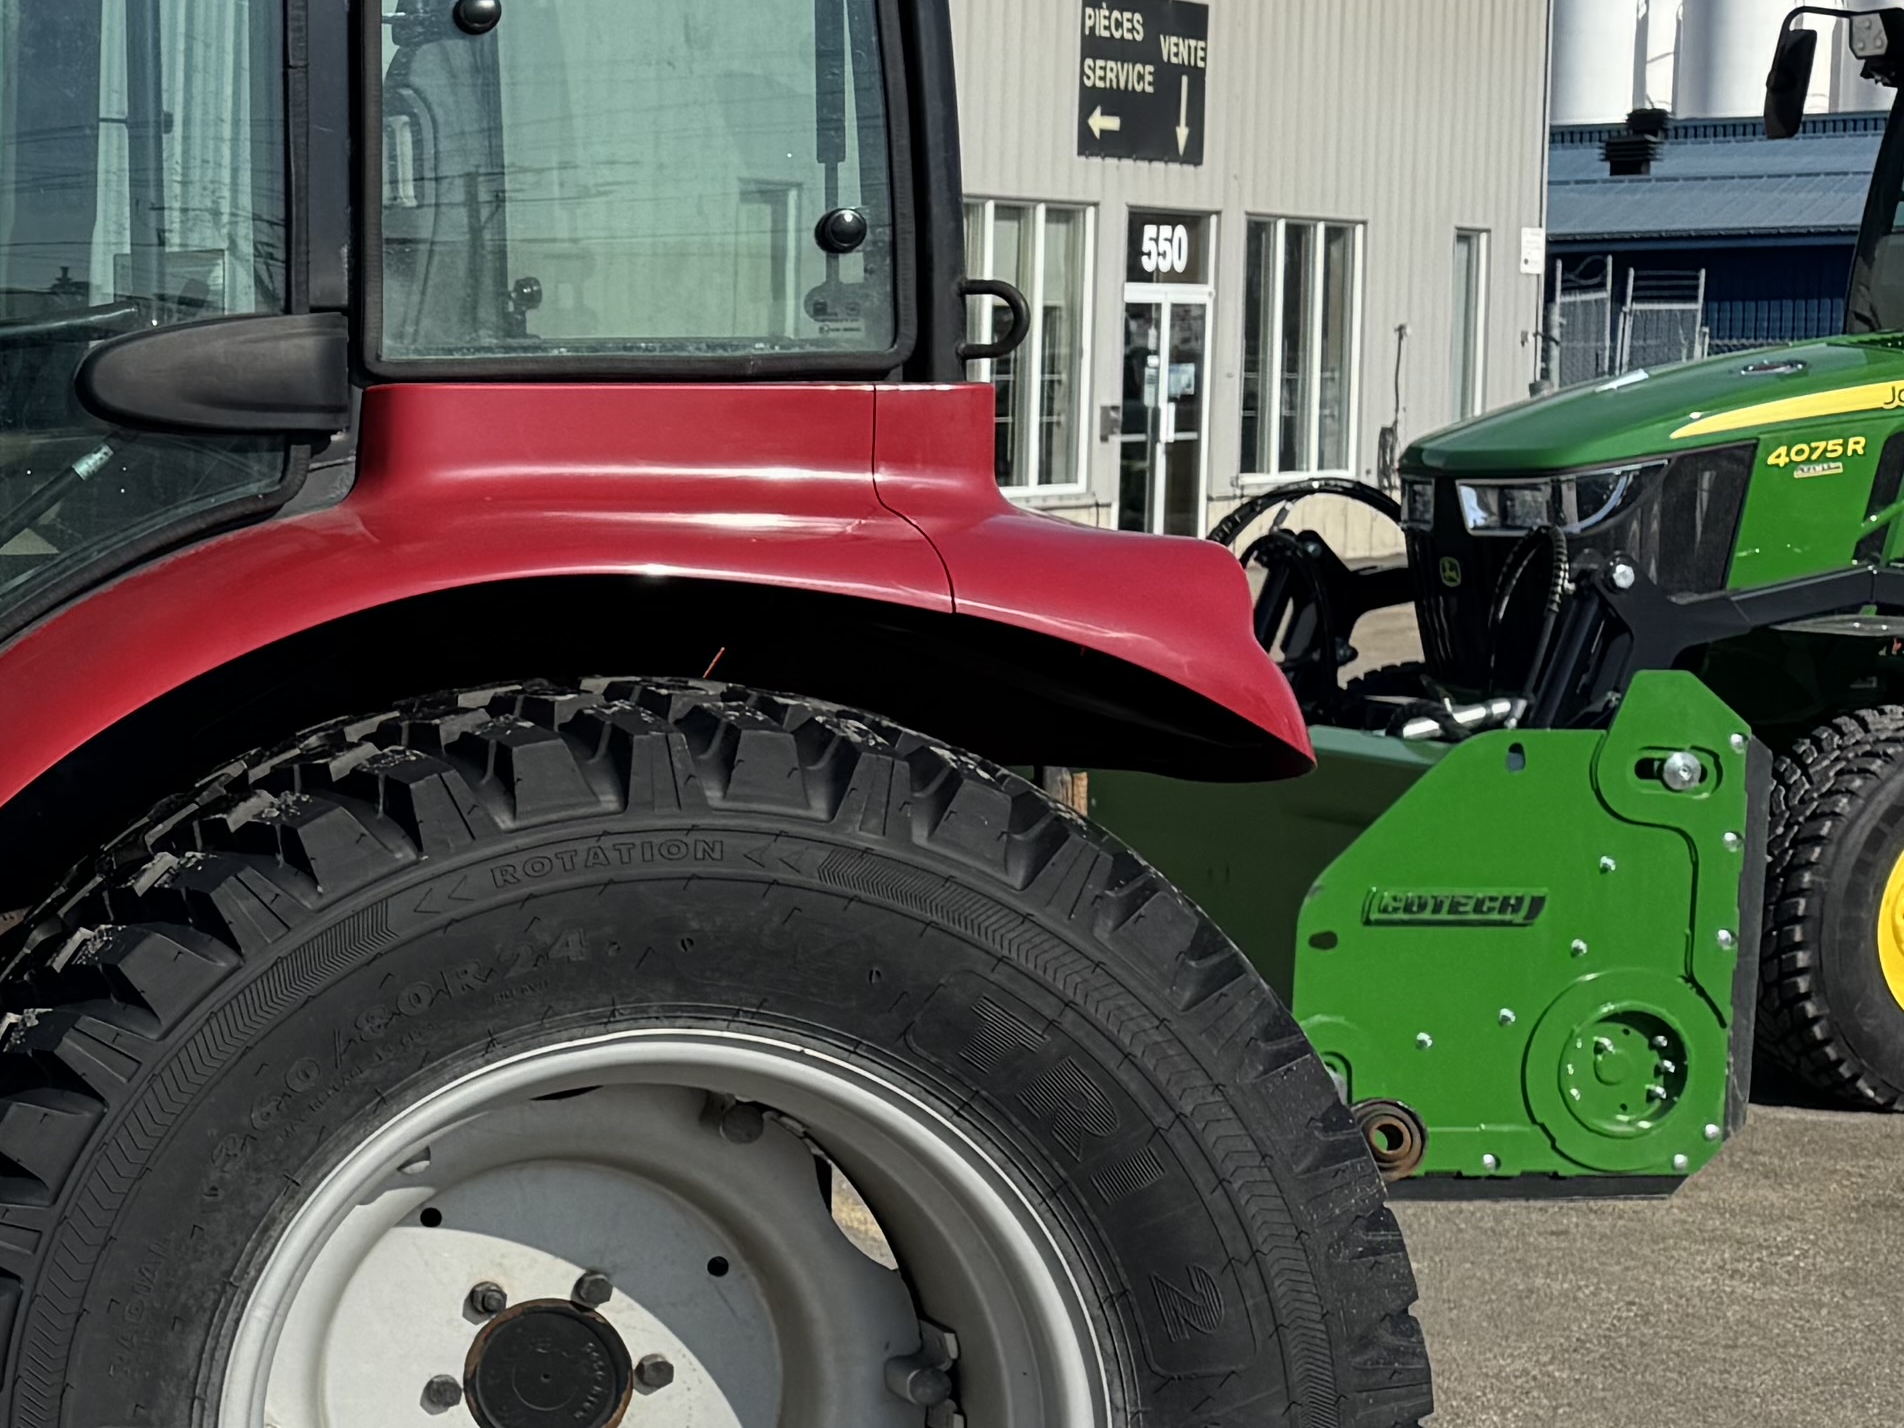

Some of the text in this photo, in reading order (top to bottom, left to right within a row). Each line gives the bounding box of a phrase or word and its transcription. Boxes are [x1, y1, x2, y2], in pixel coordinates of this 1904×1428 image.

[1084, 2, 1144, 42] PIÈCES
[1159, 34, 1206, 69] VENTE
[1083, 59, 1155, 93] SERVICE
[1141, 224, 1188, 273] 550
